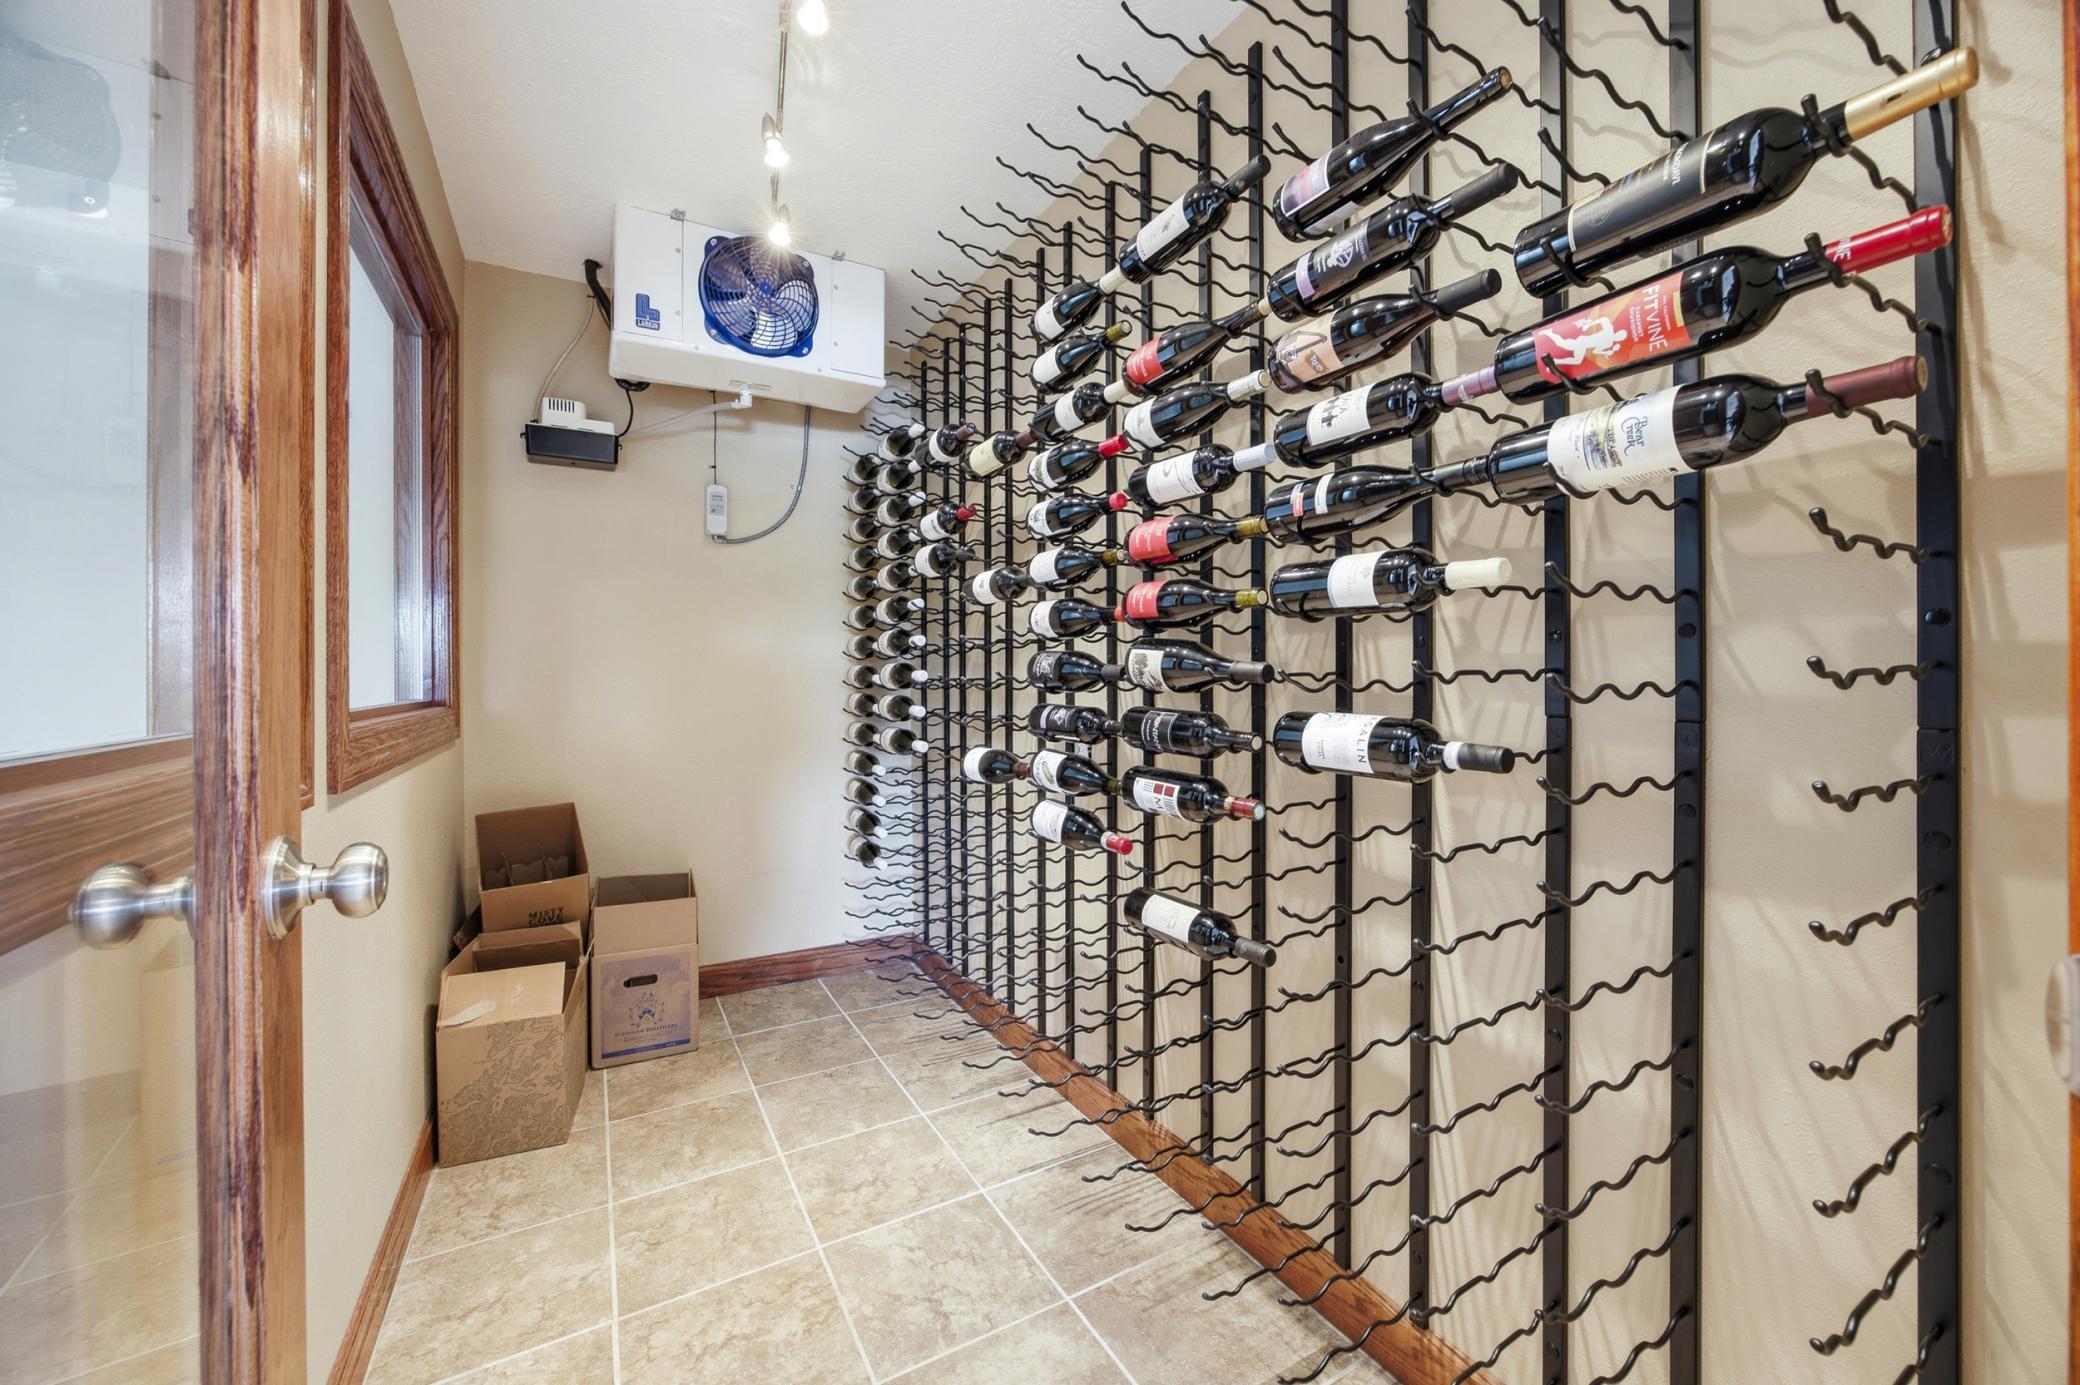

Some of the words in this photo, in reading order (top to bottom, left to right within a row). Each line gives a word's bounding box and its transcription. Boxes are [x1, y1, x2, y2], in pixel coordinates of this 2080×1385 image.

[1642, 285, 1668, 352] FITVINE
[1621, 416, 1642, 457] Creek
[1634, 416, 1648, 447] Bear
